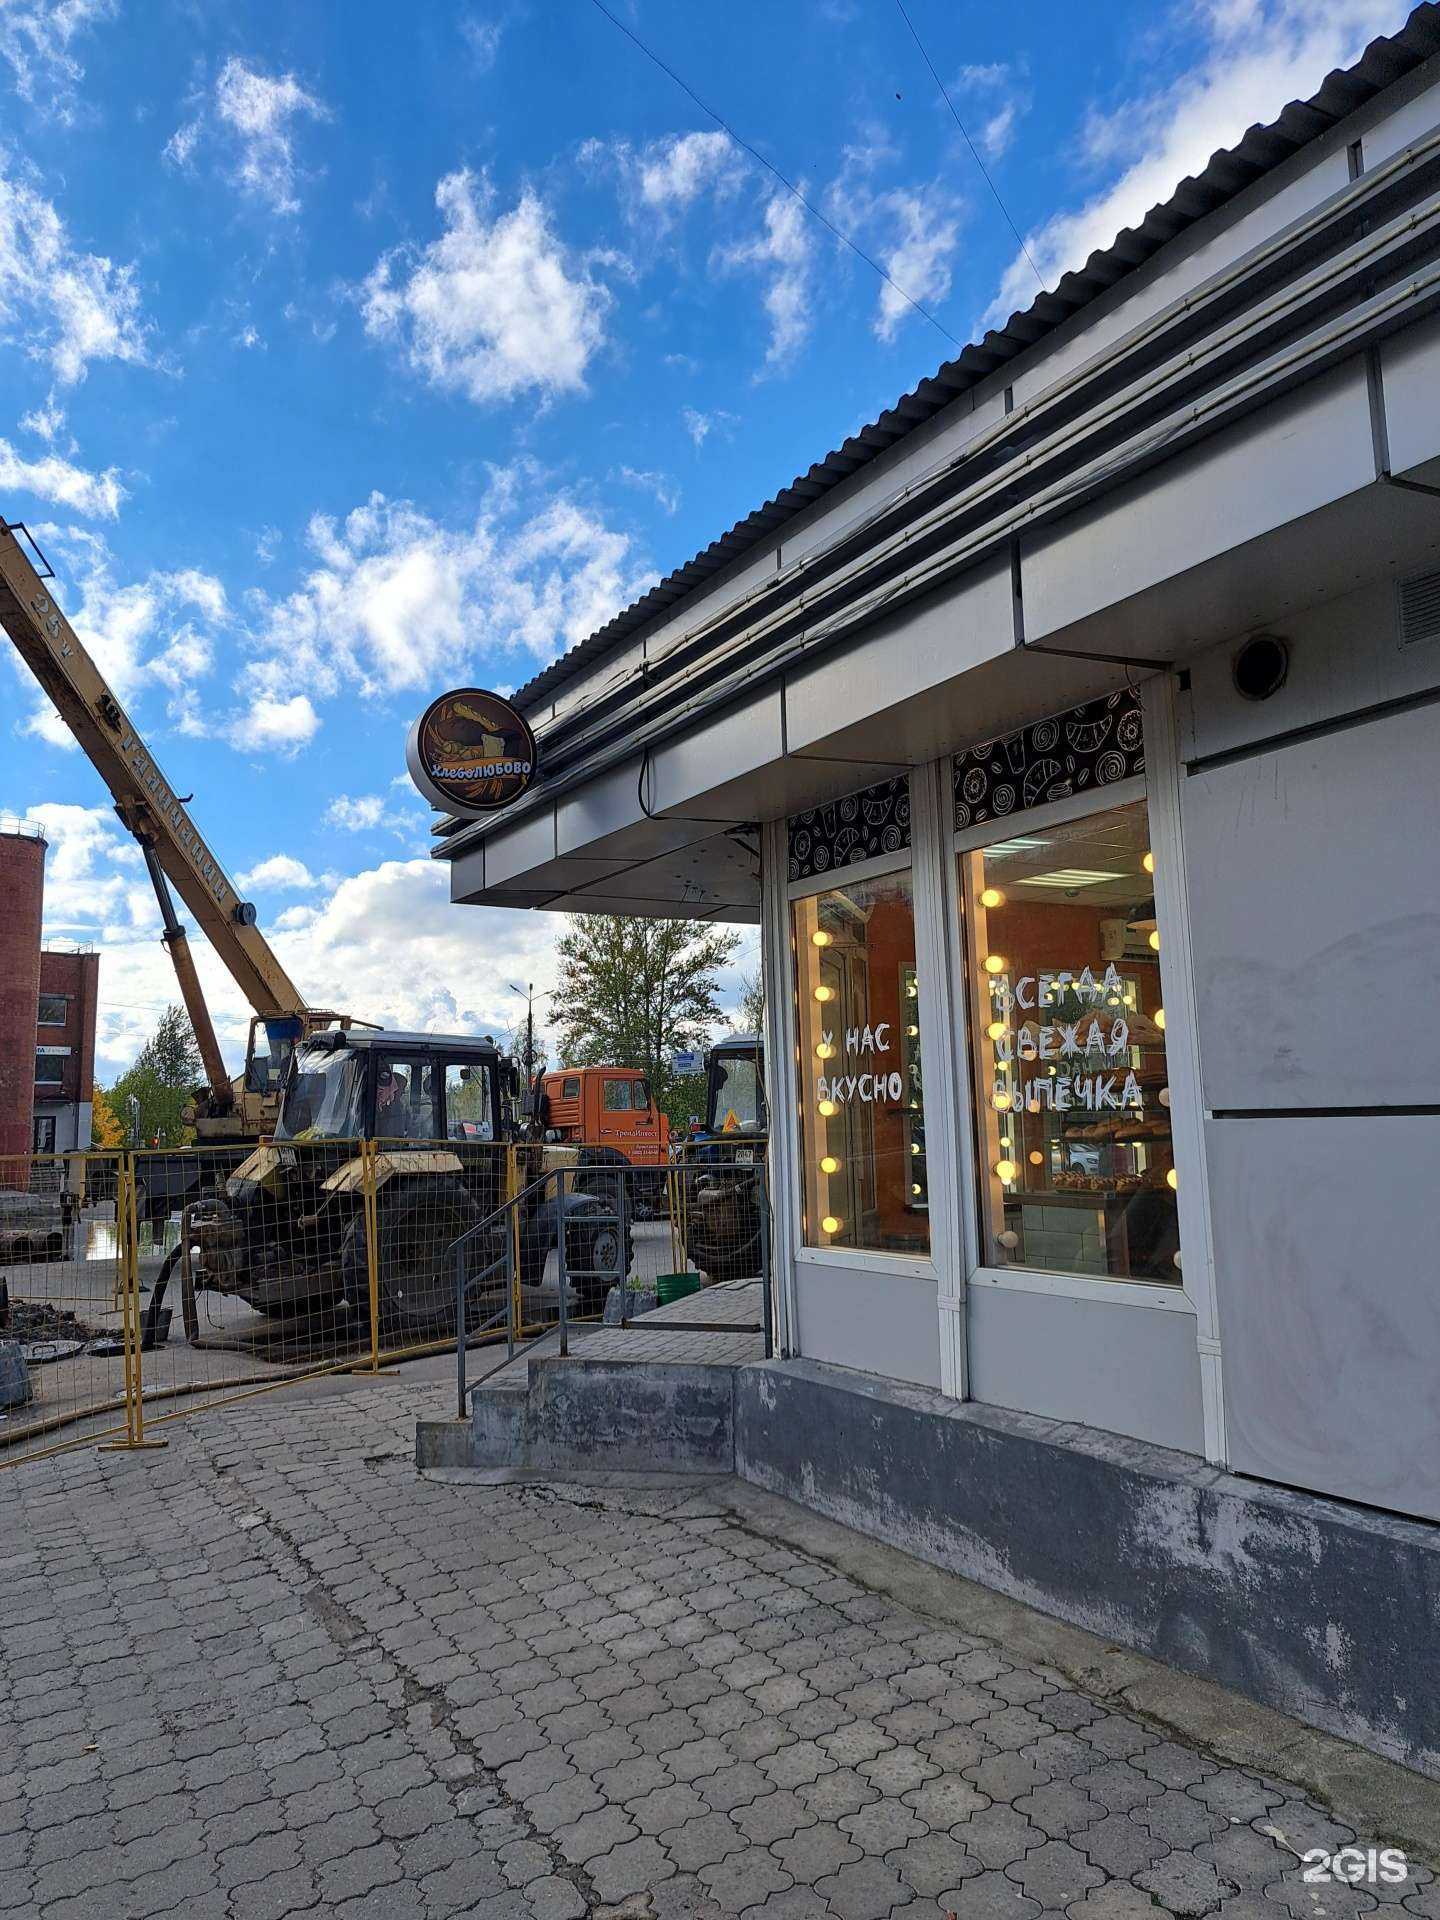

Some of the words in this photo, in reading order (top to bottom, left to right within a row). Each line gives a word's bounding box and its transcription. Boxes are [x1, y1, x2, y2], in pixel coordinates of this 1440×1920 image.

[995, 962, 1122, 1013] ВСЕГДА
[845, 1022, 890, 1057] НАС
[996, 1018, 1130, 1062] СВЕЖАЯ
[817, 1071, 902, 1104] ВКУСНО
[992, 1070, 1145, 1112] ВЫПЕЧКА
